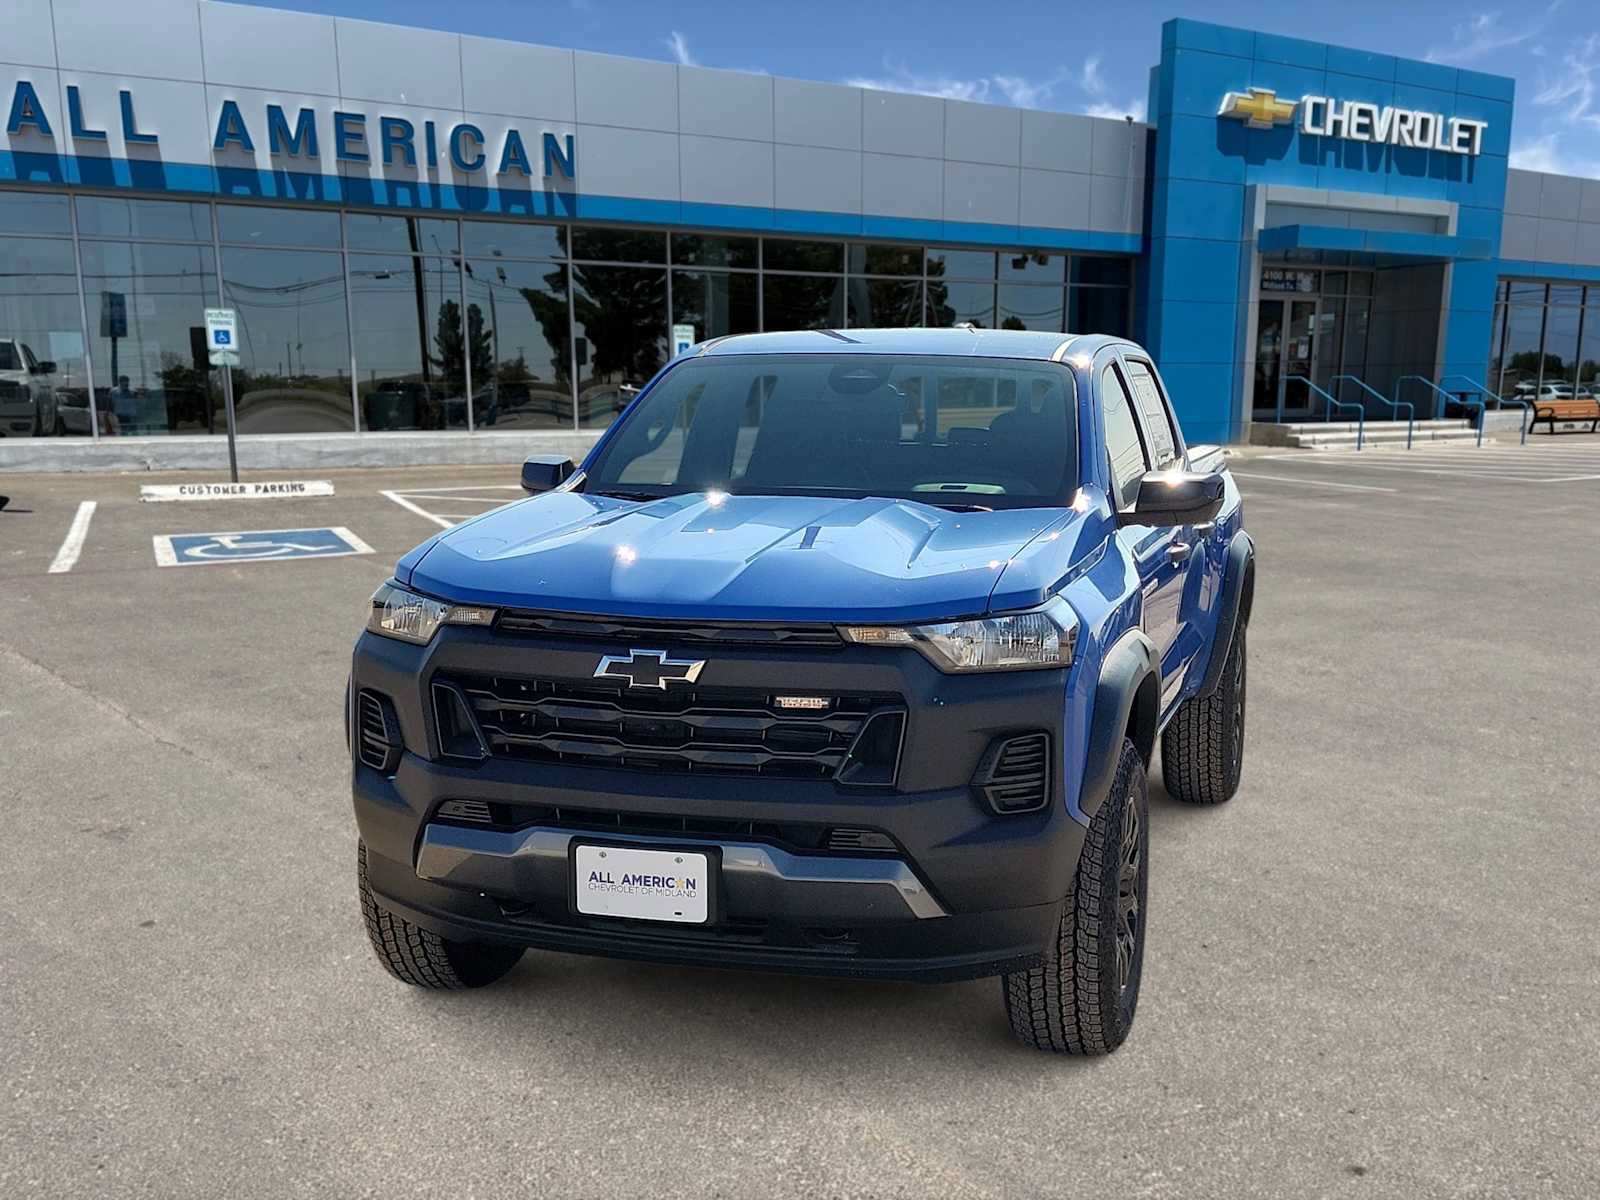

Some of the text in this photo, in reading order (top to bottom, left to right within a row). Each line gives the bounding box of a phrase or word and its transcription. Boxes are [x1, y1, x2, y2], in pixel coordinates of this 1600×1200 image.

[6, 80, 576, 180] ALL AMERICAN
[1302, 94, 1489, 155] CHEVROLET
[179, 483, 306, 495] CUSTOMER PARKING
[588, 871, 615, 884] ALL
[588, 883, 639, 895] CHEVROLET
[655, 888, 697, 898] MIDLAND
